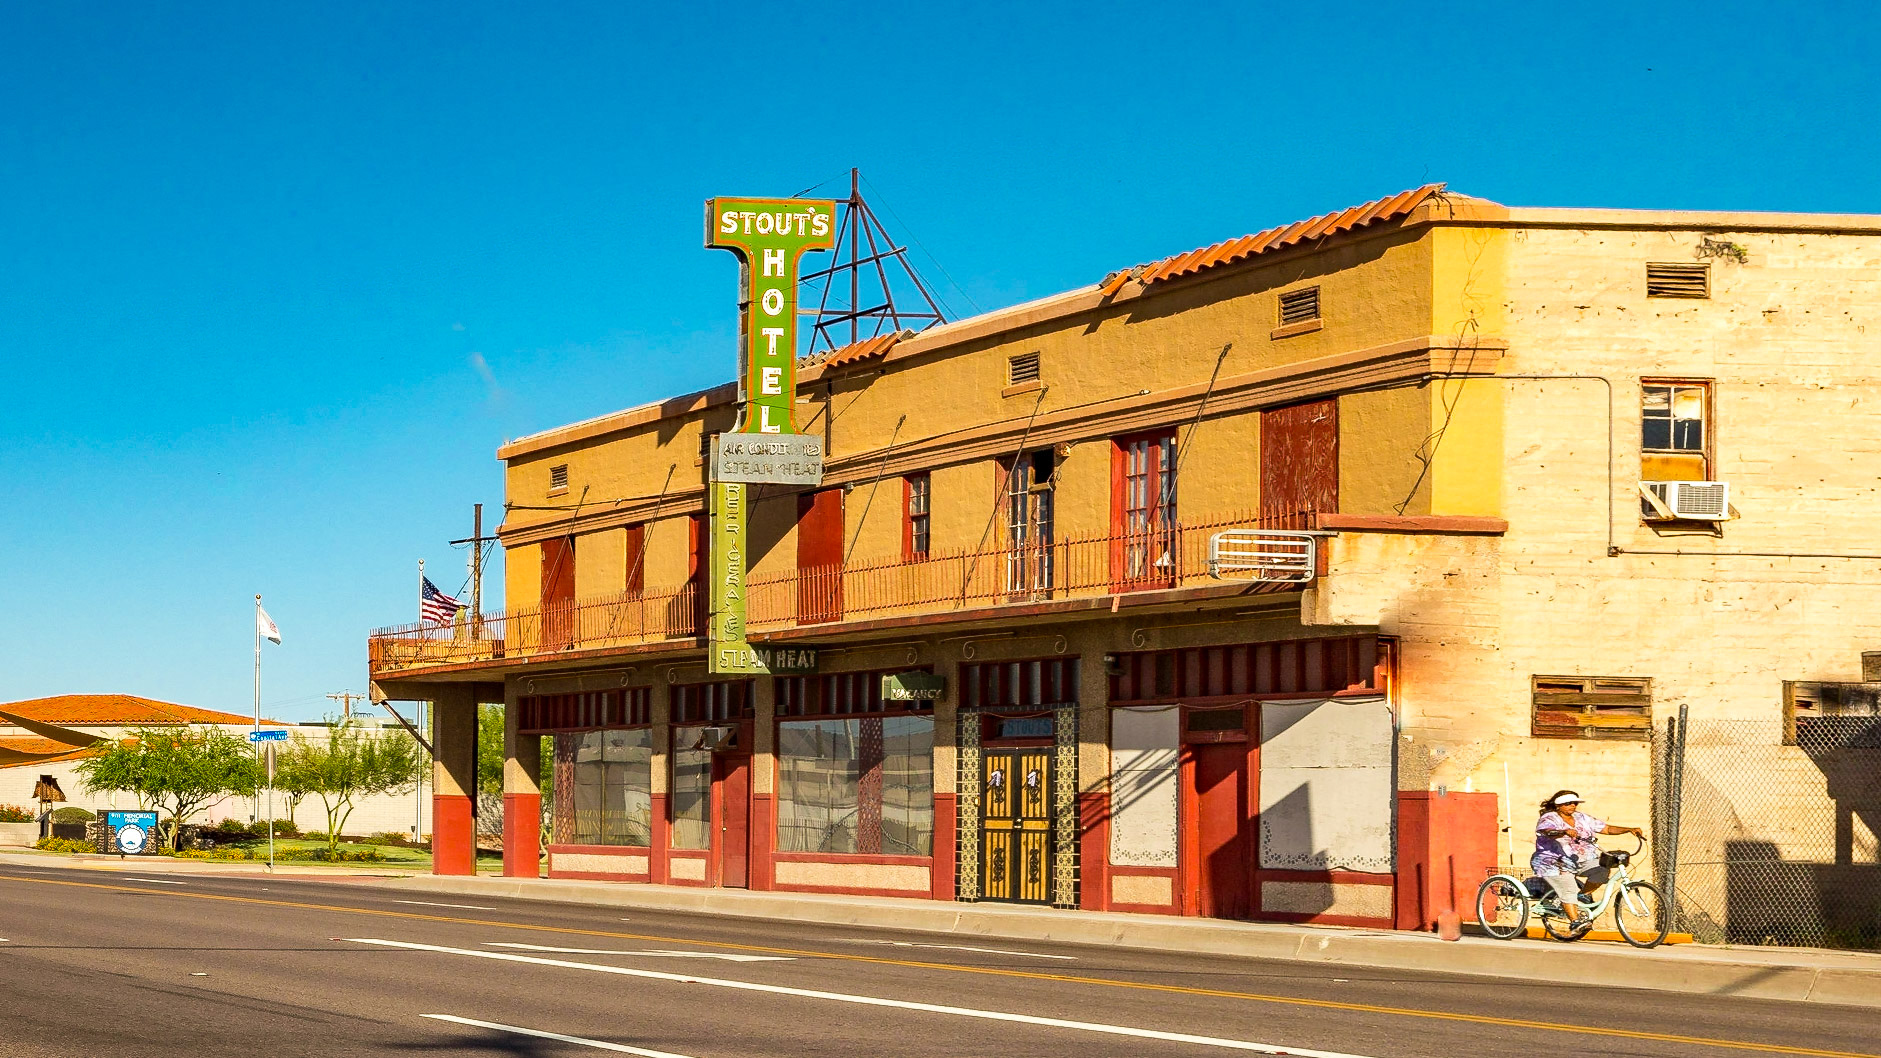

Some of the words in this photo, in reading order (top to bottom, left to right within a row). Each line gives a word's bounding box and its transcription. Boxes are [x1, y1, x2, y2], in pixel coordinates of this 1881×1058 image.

[720, 206, 829, 236] STOUT'S
[760, 249, 785, 433] HOTEL
[723, 443, 745, 457] AIR
[780, 462, 819, 475] HEAT
[720, 650, 770, 668] STEAM
[776, 650, 816, 668] HEAT
[892, 689, 941, 699] VACANCY
